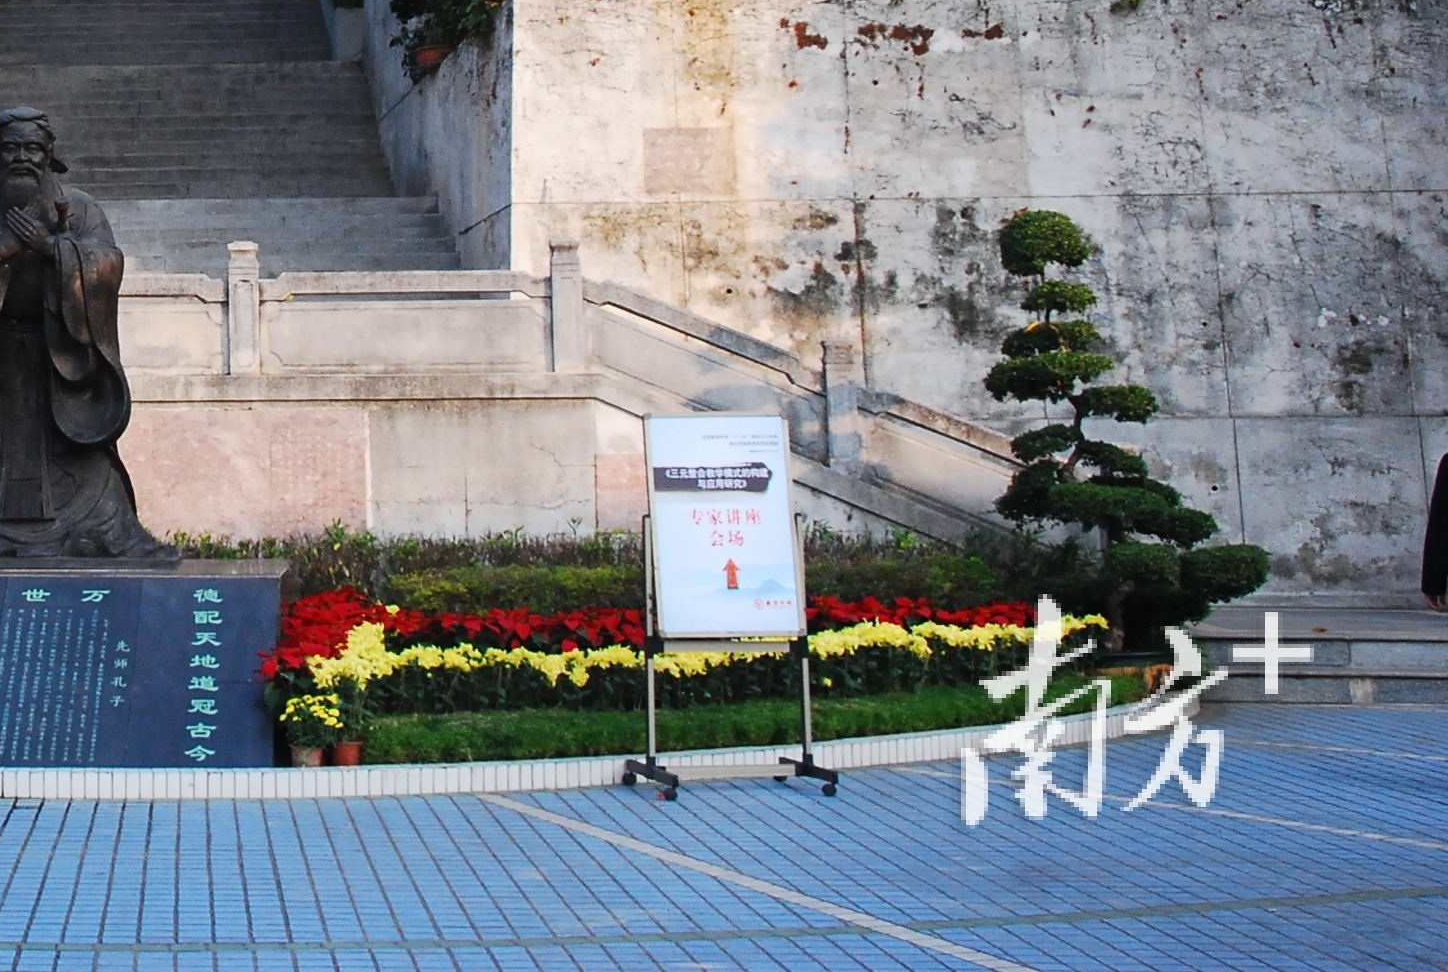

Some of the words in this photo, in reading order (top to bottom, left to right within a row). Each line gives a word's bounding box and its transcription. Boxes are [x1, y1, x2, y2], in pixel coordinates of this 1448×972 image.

[692, 508, 762, 526] 专家讲座
[710, 530, 745, 547] 会场
[110, 640, 131, 707] 先师孔子
[184, 588, 224, 762] 德配天地道冠古今
